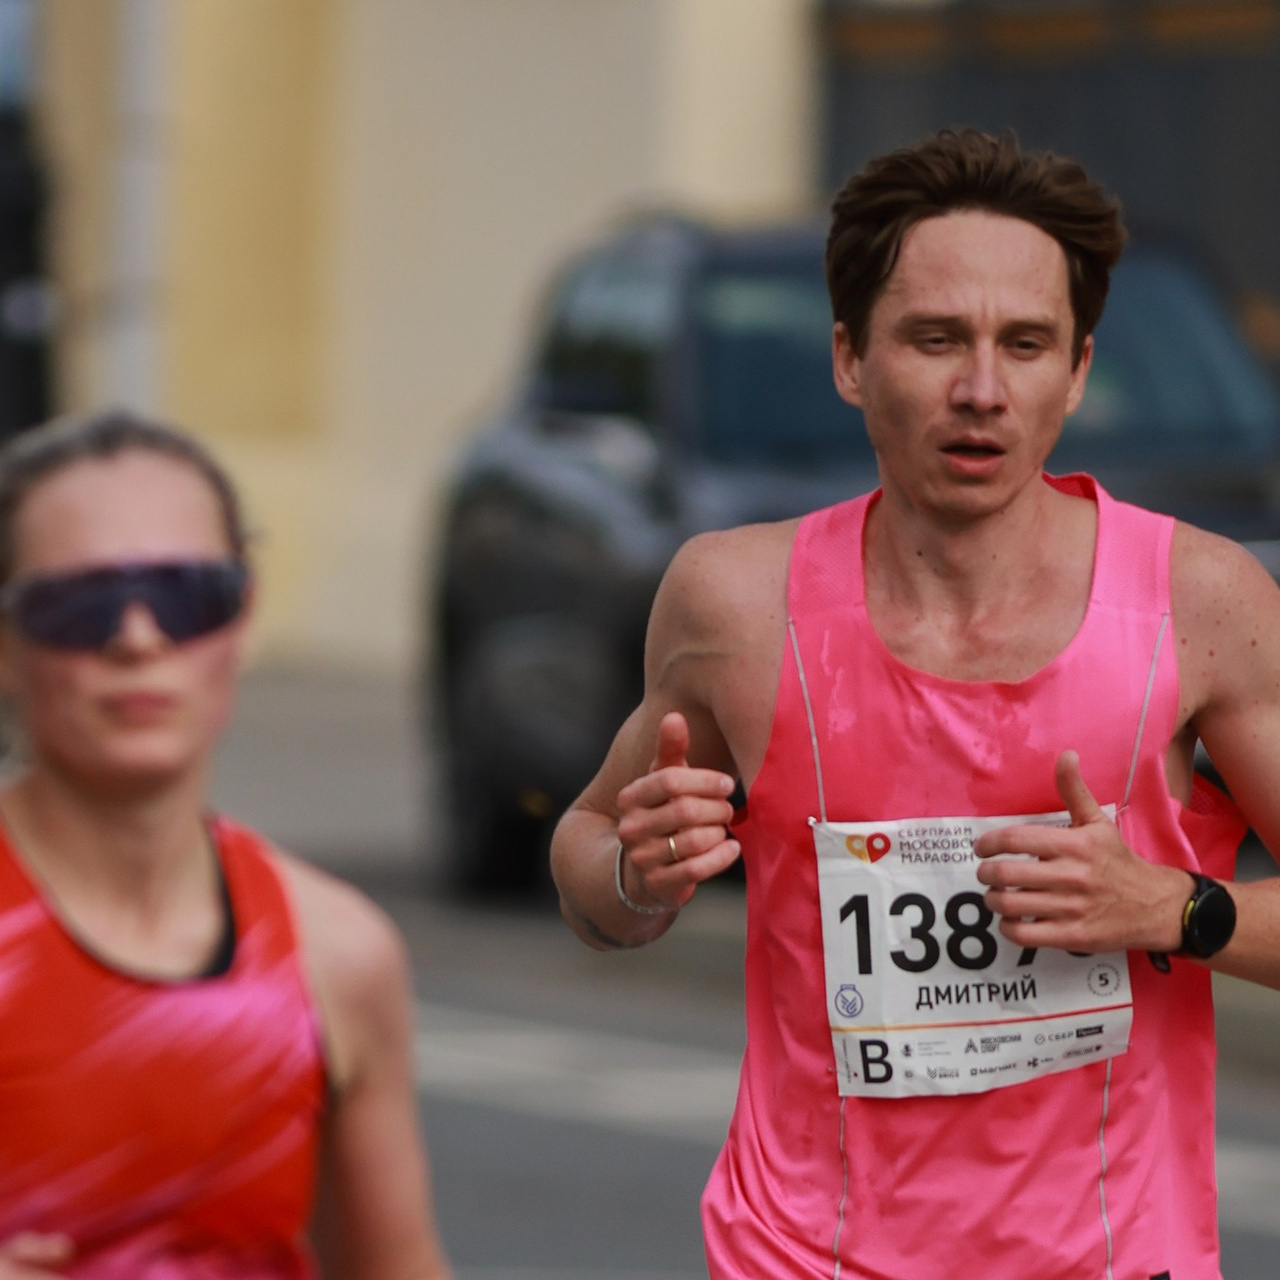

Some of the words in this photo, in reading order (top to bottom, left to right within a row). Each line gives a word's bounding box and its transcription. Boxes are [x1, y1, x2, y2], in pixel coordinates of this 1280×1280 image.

[897, 826, 972, 838] СБЕРПРАЙМ
[899, 838, 977, 851] МОСКОВСК
[901, 851, 974, 863] МАРАФОН
[839, 891, 1094, 975] 138
[1098, 972, 1110, 987] 5
[915, 973, 1037, 1011] ДМИТРИЙ
